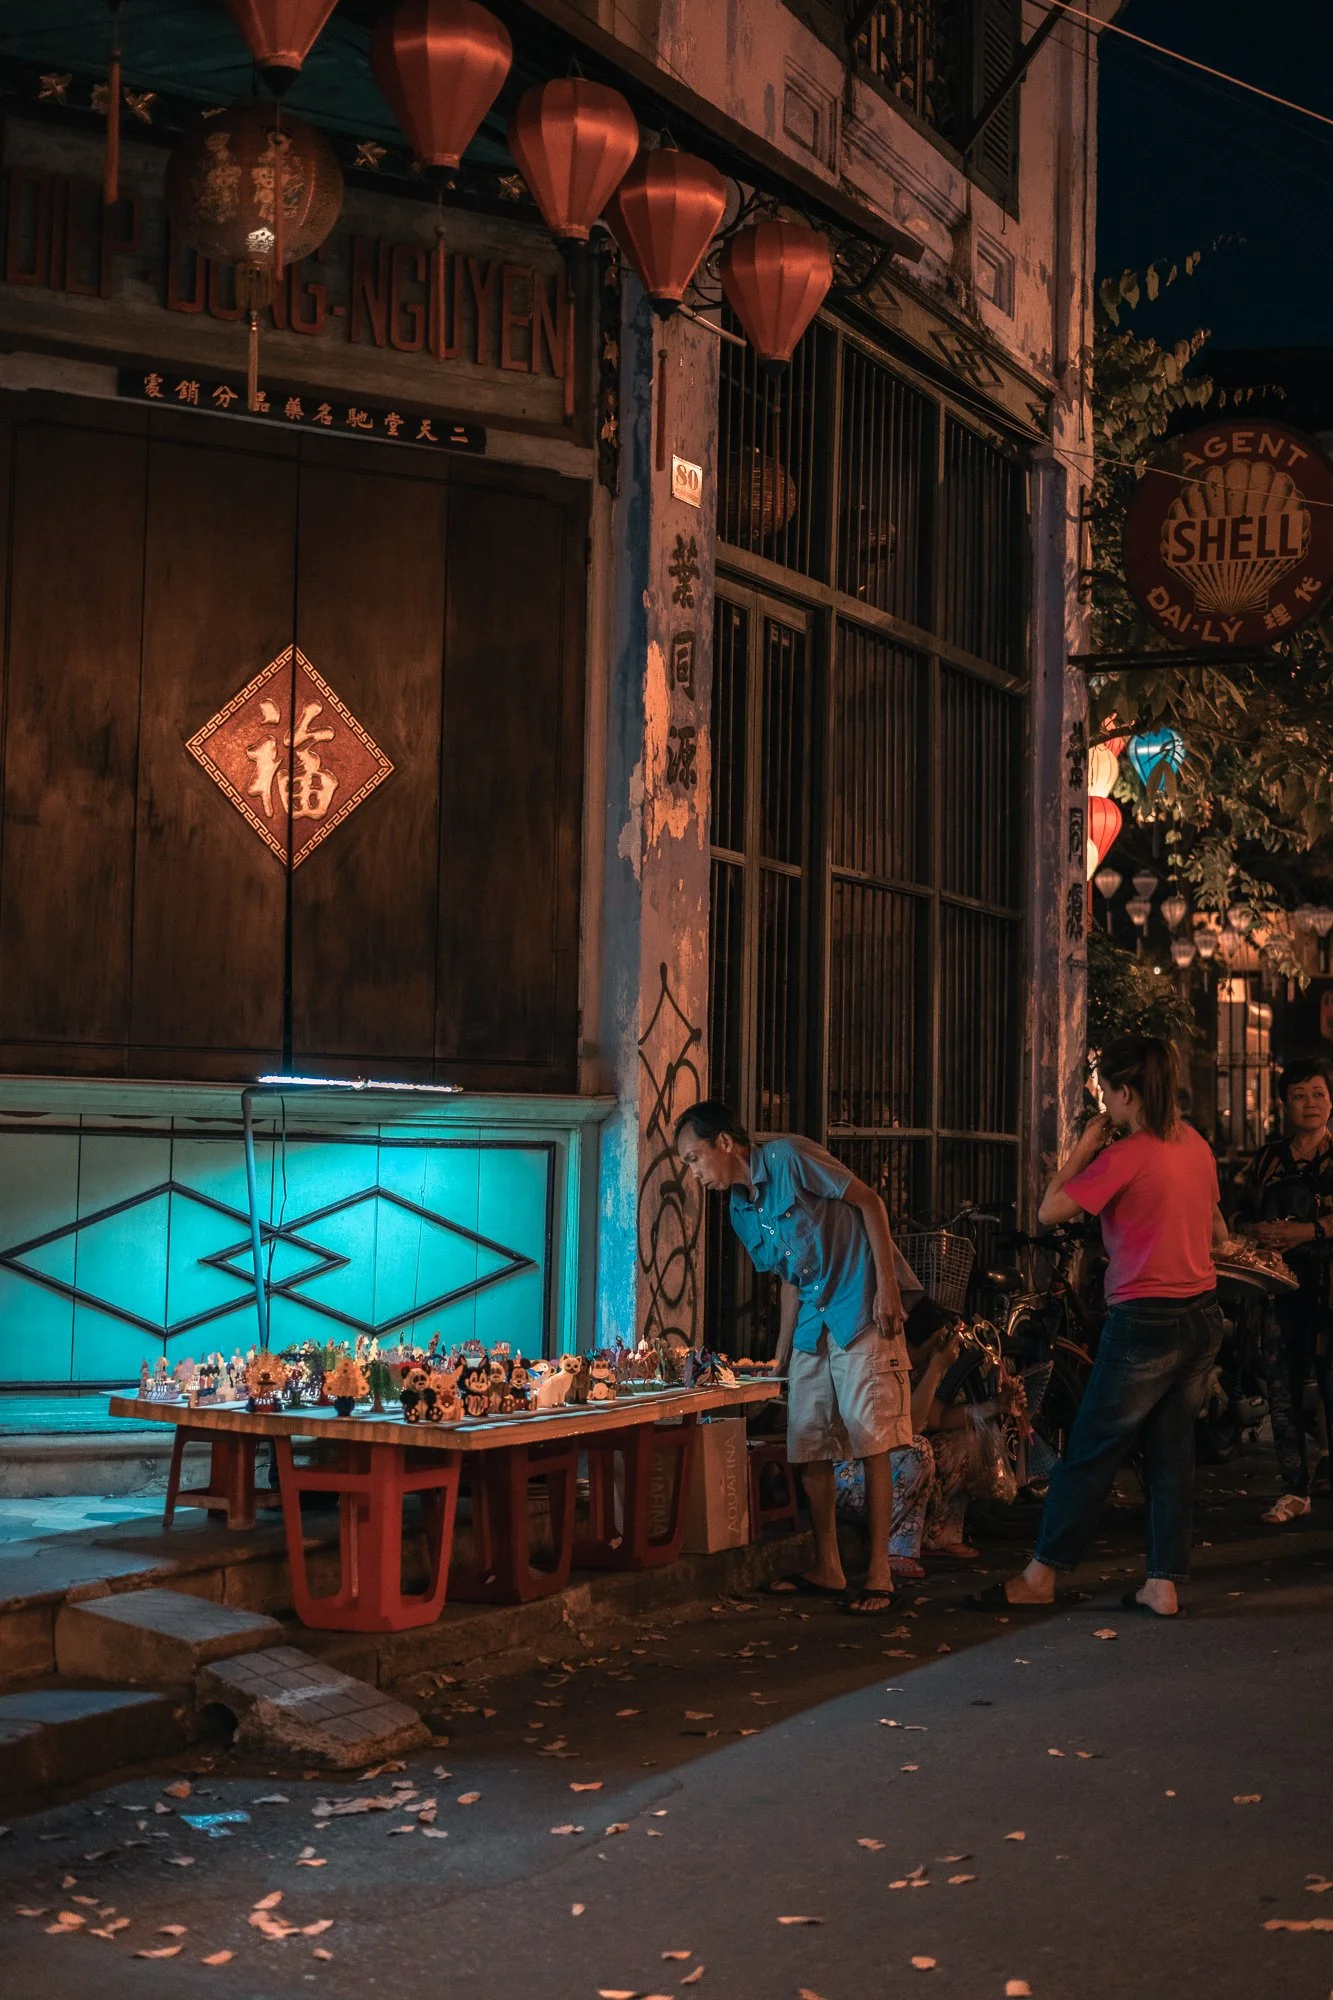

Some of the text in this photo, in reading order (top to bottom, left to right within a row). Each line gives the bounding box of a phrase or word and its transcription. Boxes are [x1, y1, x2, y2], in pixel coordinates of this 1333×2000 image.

[676, 465, 698, 490] 80
[1182, 431, 1309, 473] AGENT
[1172, 514, 1299, 563] SHELL
[246, 698, 340, 821] 福
[648, 1453, 668, 1538] QUAFINA
[724, 1434, 741, 1533] AQUAFINA
